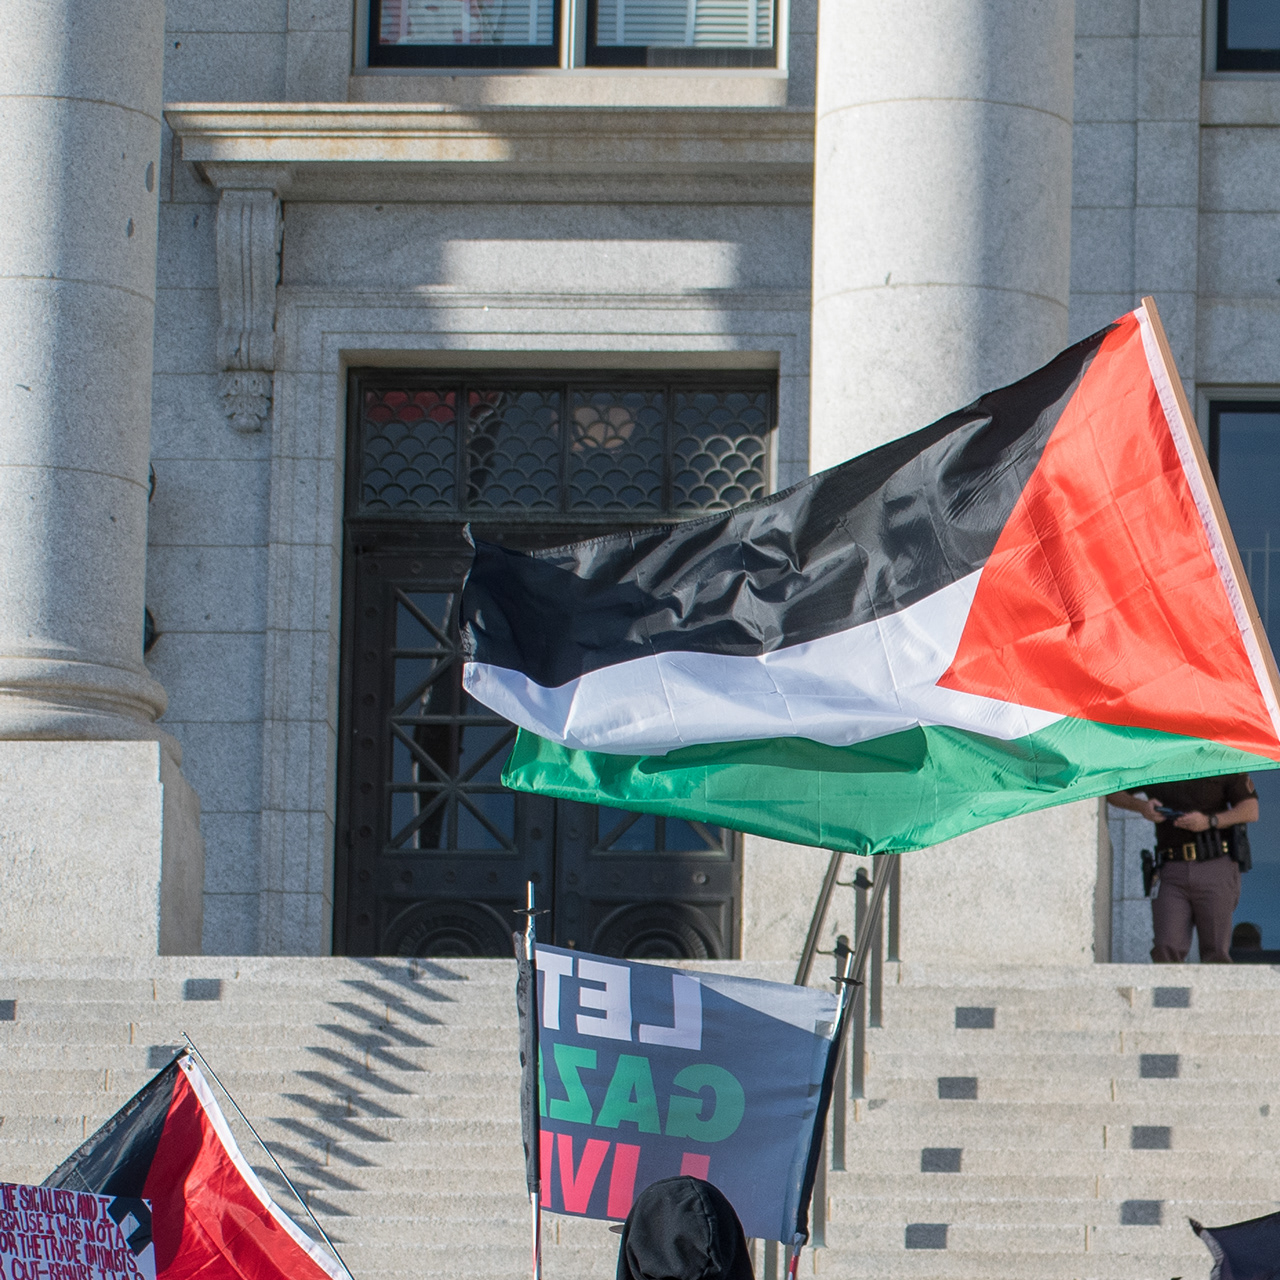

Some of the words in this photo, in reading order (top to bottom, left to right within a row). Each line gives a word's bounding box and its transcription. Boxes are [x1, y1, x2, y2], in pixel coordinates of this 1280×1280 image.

[77, 1193, 98, 1222] AND
[98, 1198, 110, 1223] I
[0, 1209, 44, 1234] ECAUSE
[46, 1213, 55, 1234] I
[56, 1216, 84, 1241] WAS
[84, 1222, 114, 1250] NOT
[115, 1225, 128, 1250] A
[0, 1231, 18, 1257] OR
[17, 1233, 42, 1259] THE
[41, 1234, 81, 1265] TRADE
